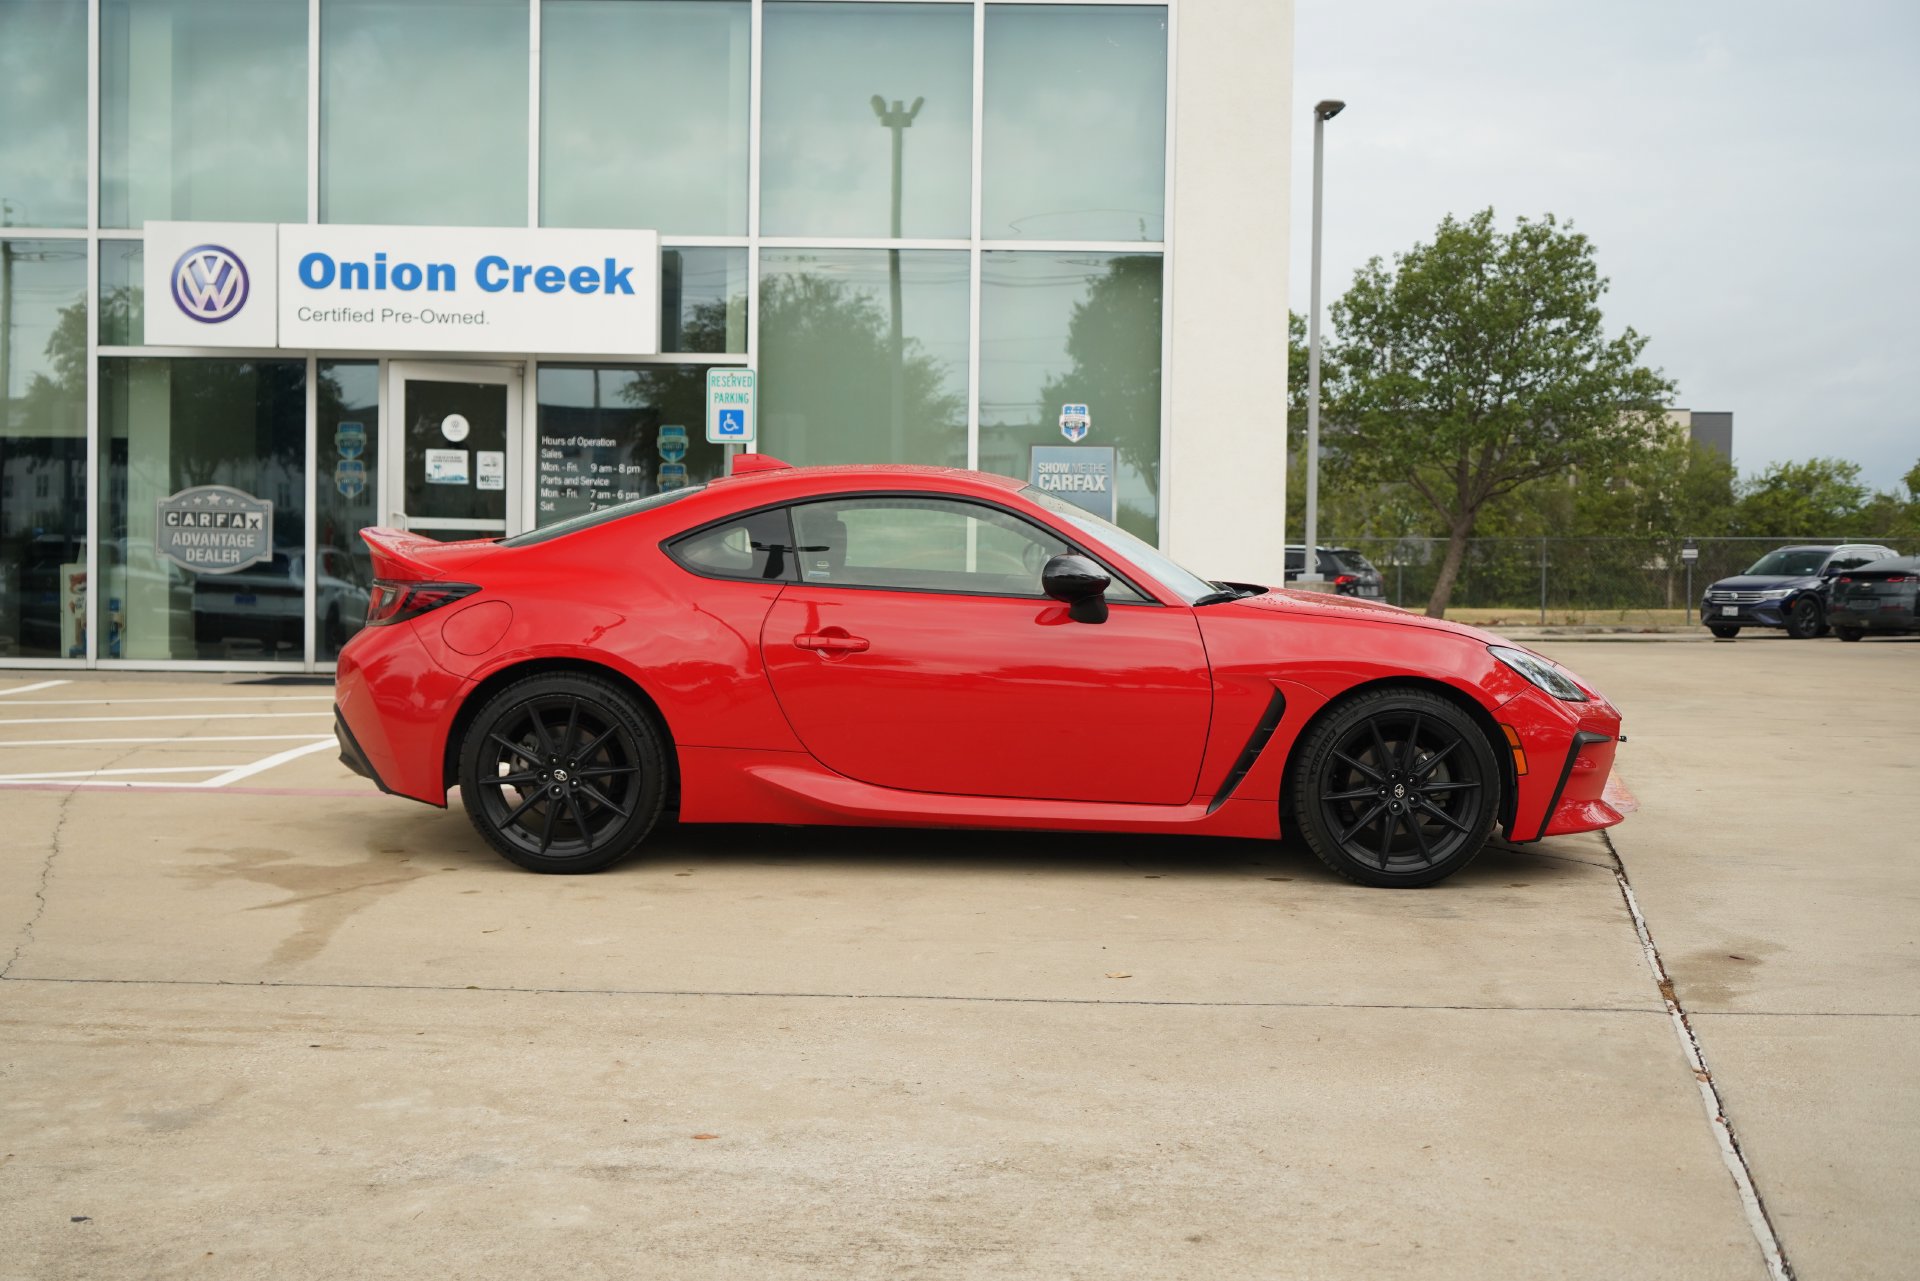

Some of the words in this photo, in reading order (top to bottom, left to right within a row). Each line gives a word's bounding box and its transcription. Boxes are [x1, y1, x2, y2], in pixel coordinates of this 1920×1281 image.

[298, 252, 456, 291] Onion
[475, 255, 635, 294] Creek
[298, 306, 374, 323] Certified
[381, 308, 490, 325] Pre-Owned.
[711, 376, 753, 387] RESERVED
[714, 393, 749, 403] PARKING
[541, 436, 566, 446] Hours
[567, 436, 576, 446] of
[577, 437, 617, 448] Operation
[541, 448, 563, 459] Sales
[541, 462, 560, 472] Mon.
[590, 463, 598, 473] 9
[599, 465, 612, 473] am
[618, 464, 625, 473] 8
[626, 465, 641, 475] pm
[1038, 462, 1070, 474] SHOW
[1071, 463, 1087, 474] ME
[1089, 463, 1106, 474] THE
[540, 475, 562, 486] Parts
[563, 476, 579, 485] and
[580, 476, 610, 486] Service
[1038, 474, 1107, 492] CARFAX
[590, 489, 597, 499] 7
[597, 491, 611, 499] am
[617, 489, 624, 499] 6
[625, 491, 640, 501] pm
[540, 501, 555, 511] Sat.
[590, 502, 597, 511] 7
[165, 512, 262, 529] CARFAX
[172, 532, 255, 548] ADVANTAGE
[186, 548, 241, 562] DEALER
